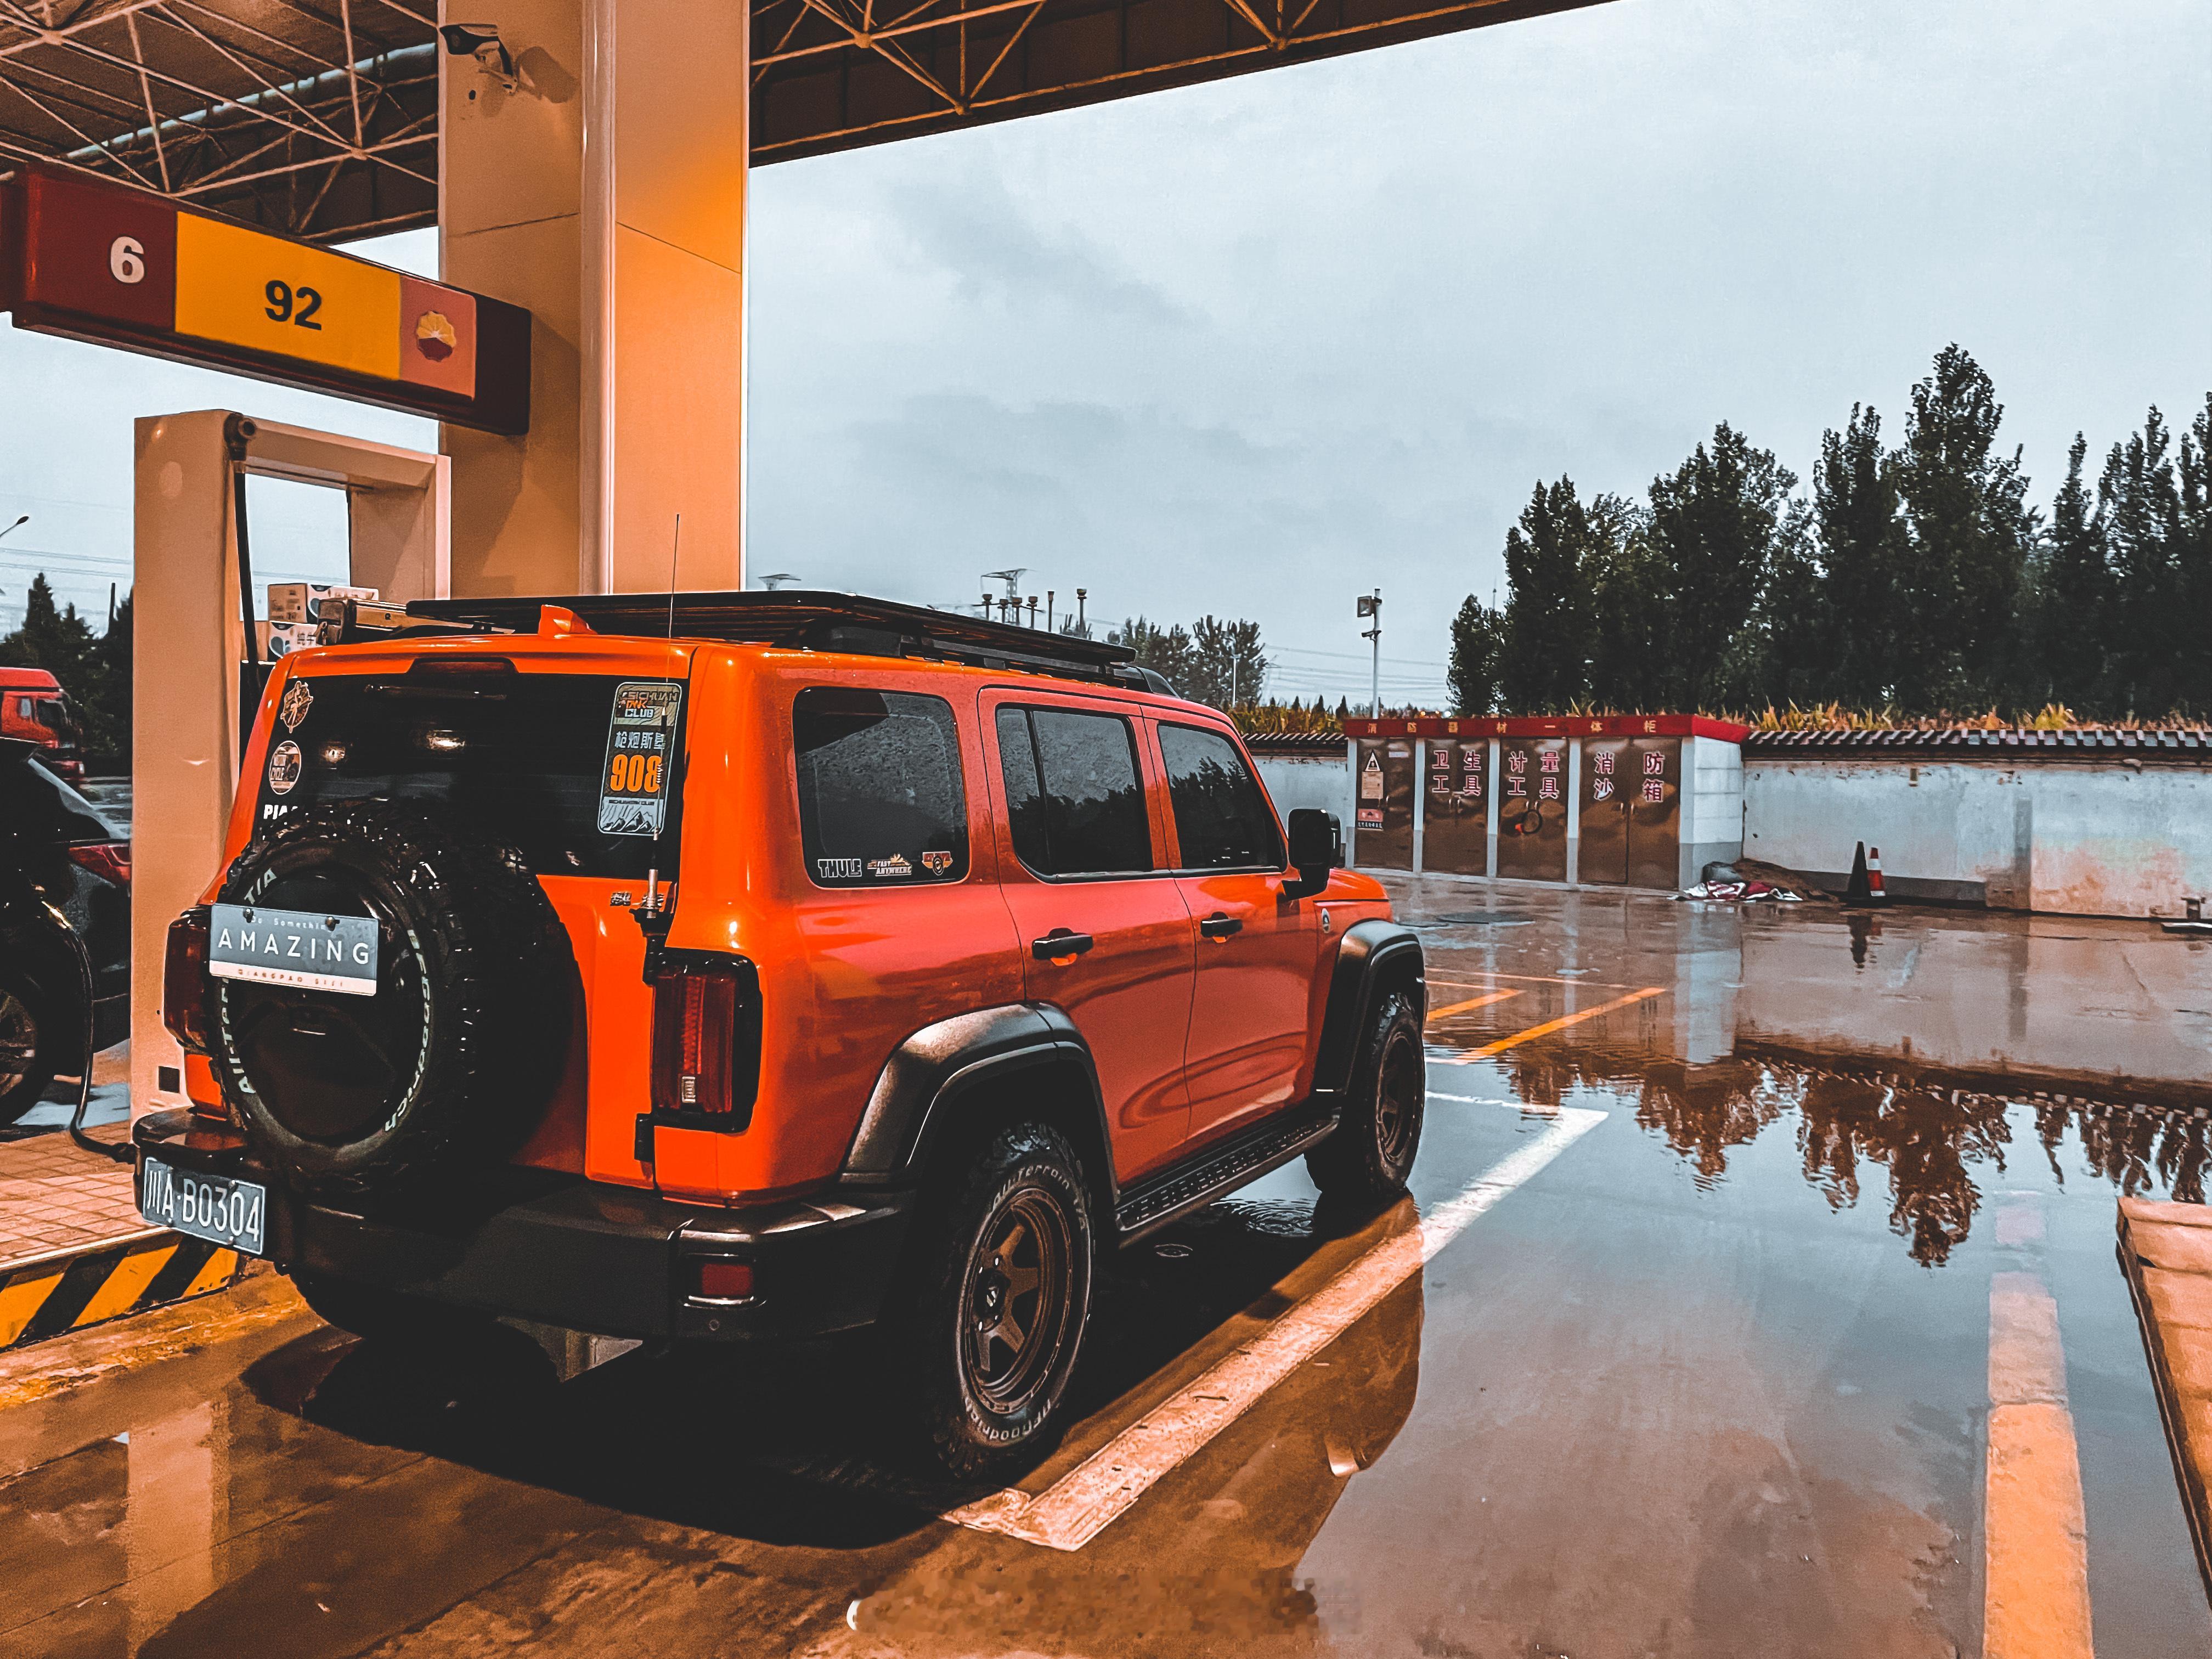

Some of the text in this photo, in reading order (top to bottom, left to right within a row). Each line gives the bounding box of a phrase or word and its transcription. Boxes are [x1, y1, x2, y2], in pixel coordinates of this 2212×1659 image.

[109, 236, 145, 284] 6
[264, 280, 323, 330] 92
[624, 708, 654, 718] CLUB
[1432, 750, 1481, 771] 卫生
[1508, 751, 1560, 774] 计量
[1594, 752, 1665, 775] 消防
[610, 754, 663, 793] 908
[1432, 775, 1482, 797] 工具
[1508, 777, 1560, 800] 工具
[1593, 777, 1664, 804] 沙箱
[263, 804, 298, 819] PIA
[818, 859, 862, 878] THULE
[244, 867, 277, 905] T/A
[274, 918, 331, 933] Somethin
[218, 928, 369, 964] AMAZING
[221, 979, 256, 1094] All-Ter
